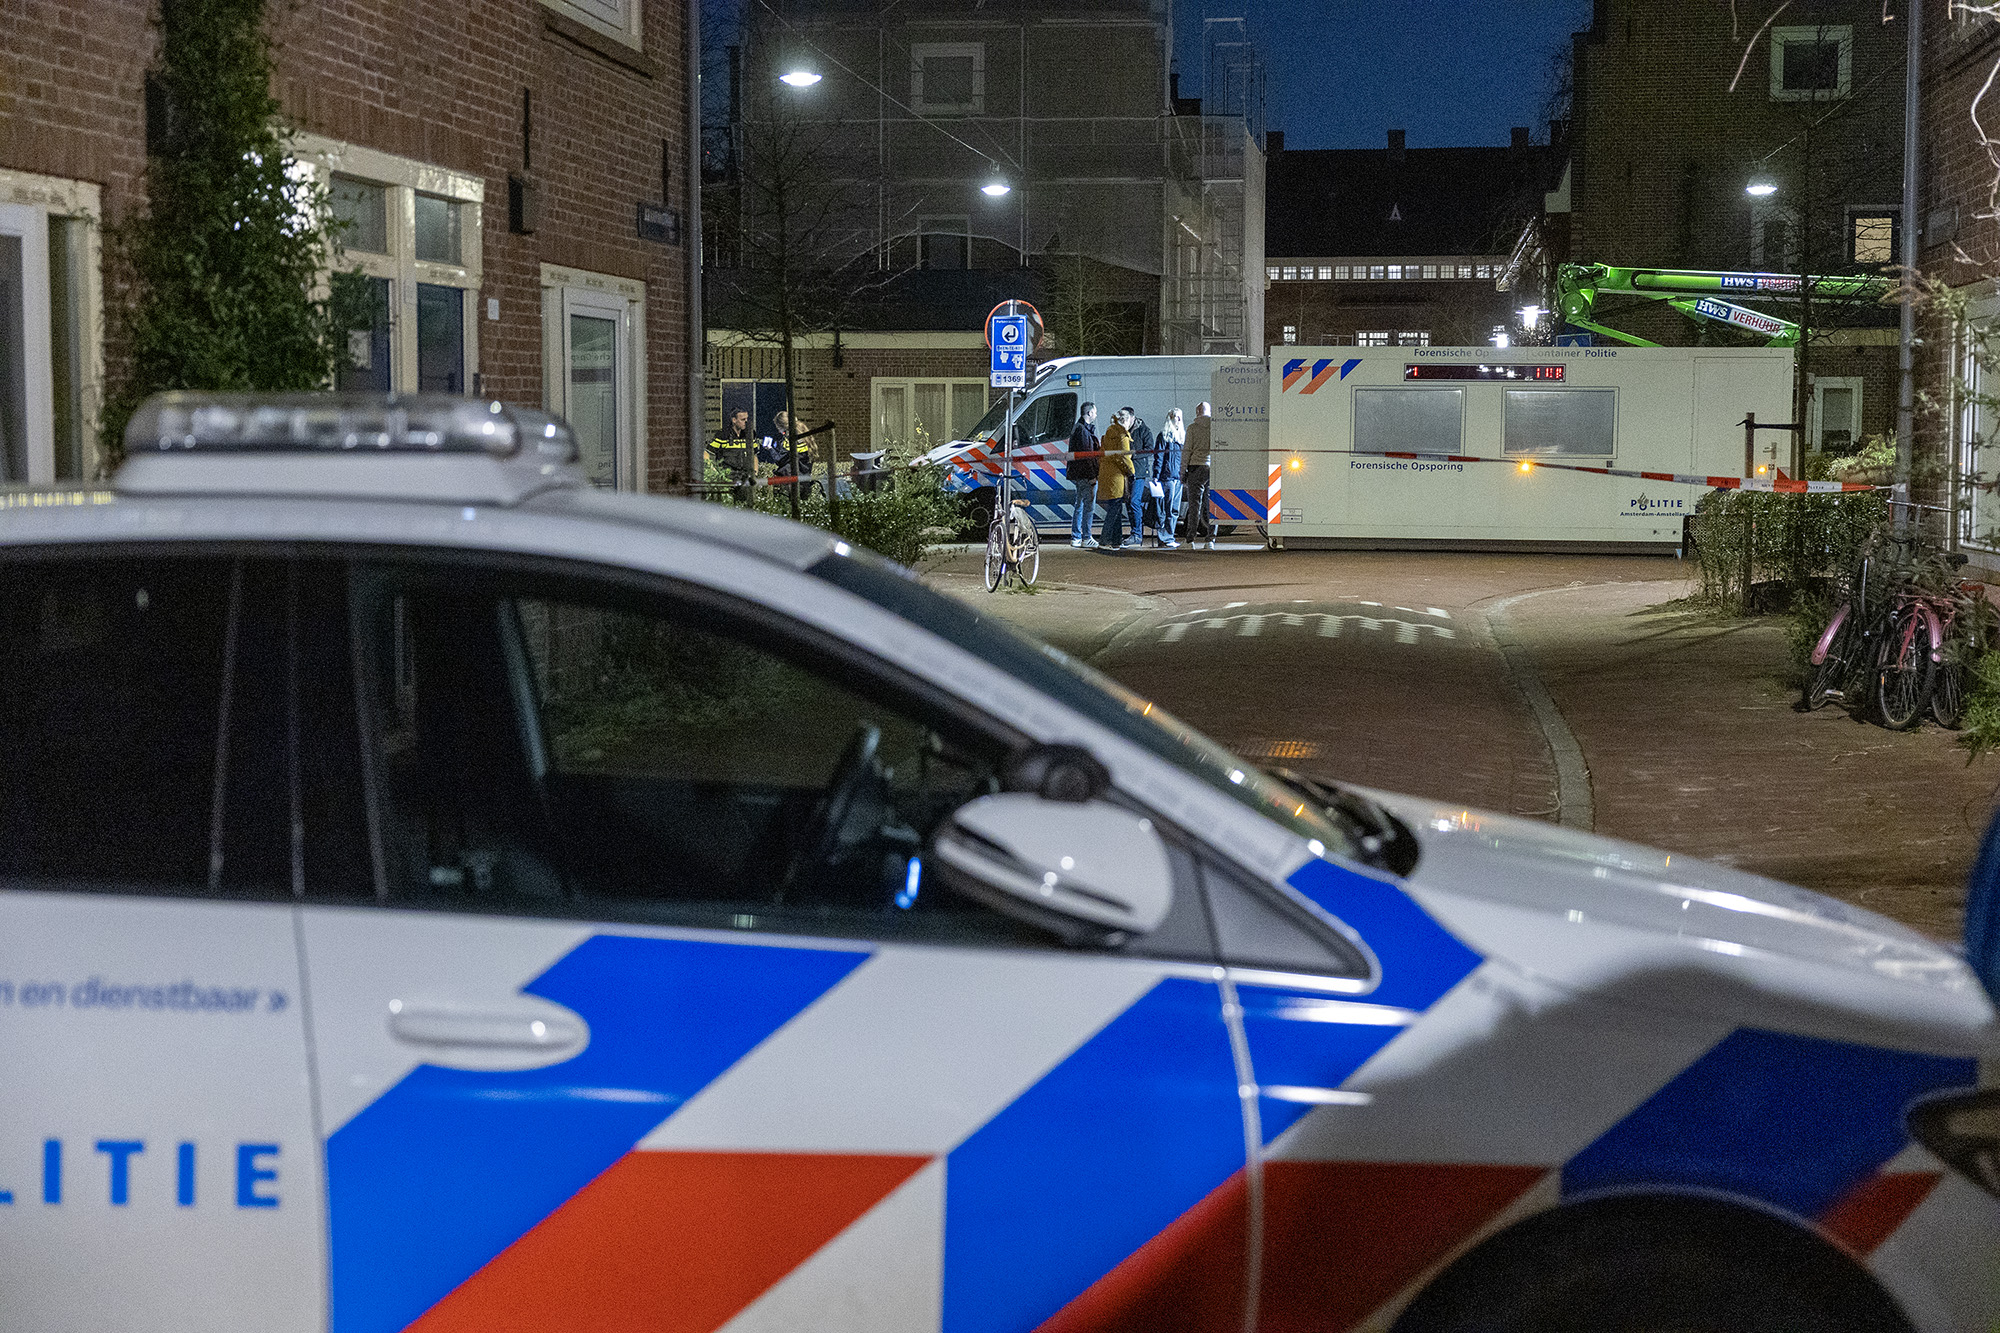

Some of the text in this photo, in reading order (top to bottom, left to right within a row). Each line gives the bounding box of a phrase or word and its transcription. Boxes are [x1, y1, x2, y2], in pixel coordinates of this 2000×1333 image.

[1722, 276, 1755, 288] HWS
[1697, 300, 1728, 318] HWS
[1413, 348, 1472, 357] Forensische
[1584, 348, 1617, 358] Politie
[1003, 375, 1021, 383] 1369
[1350, 461, 1463, 472] Forensische Opsporing
[1631, 498, 1683, 511] POLITIE
[18, 983, 67, 1008] en
[70, 976, 260, 1013] dienstbaar
